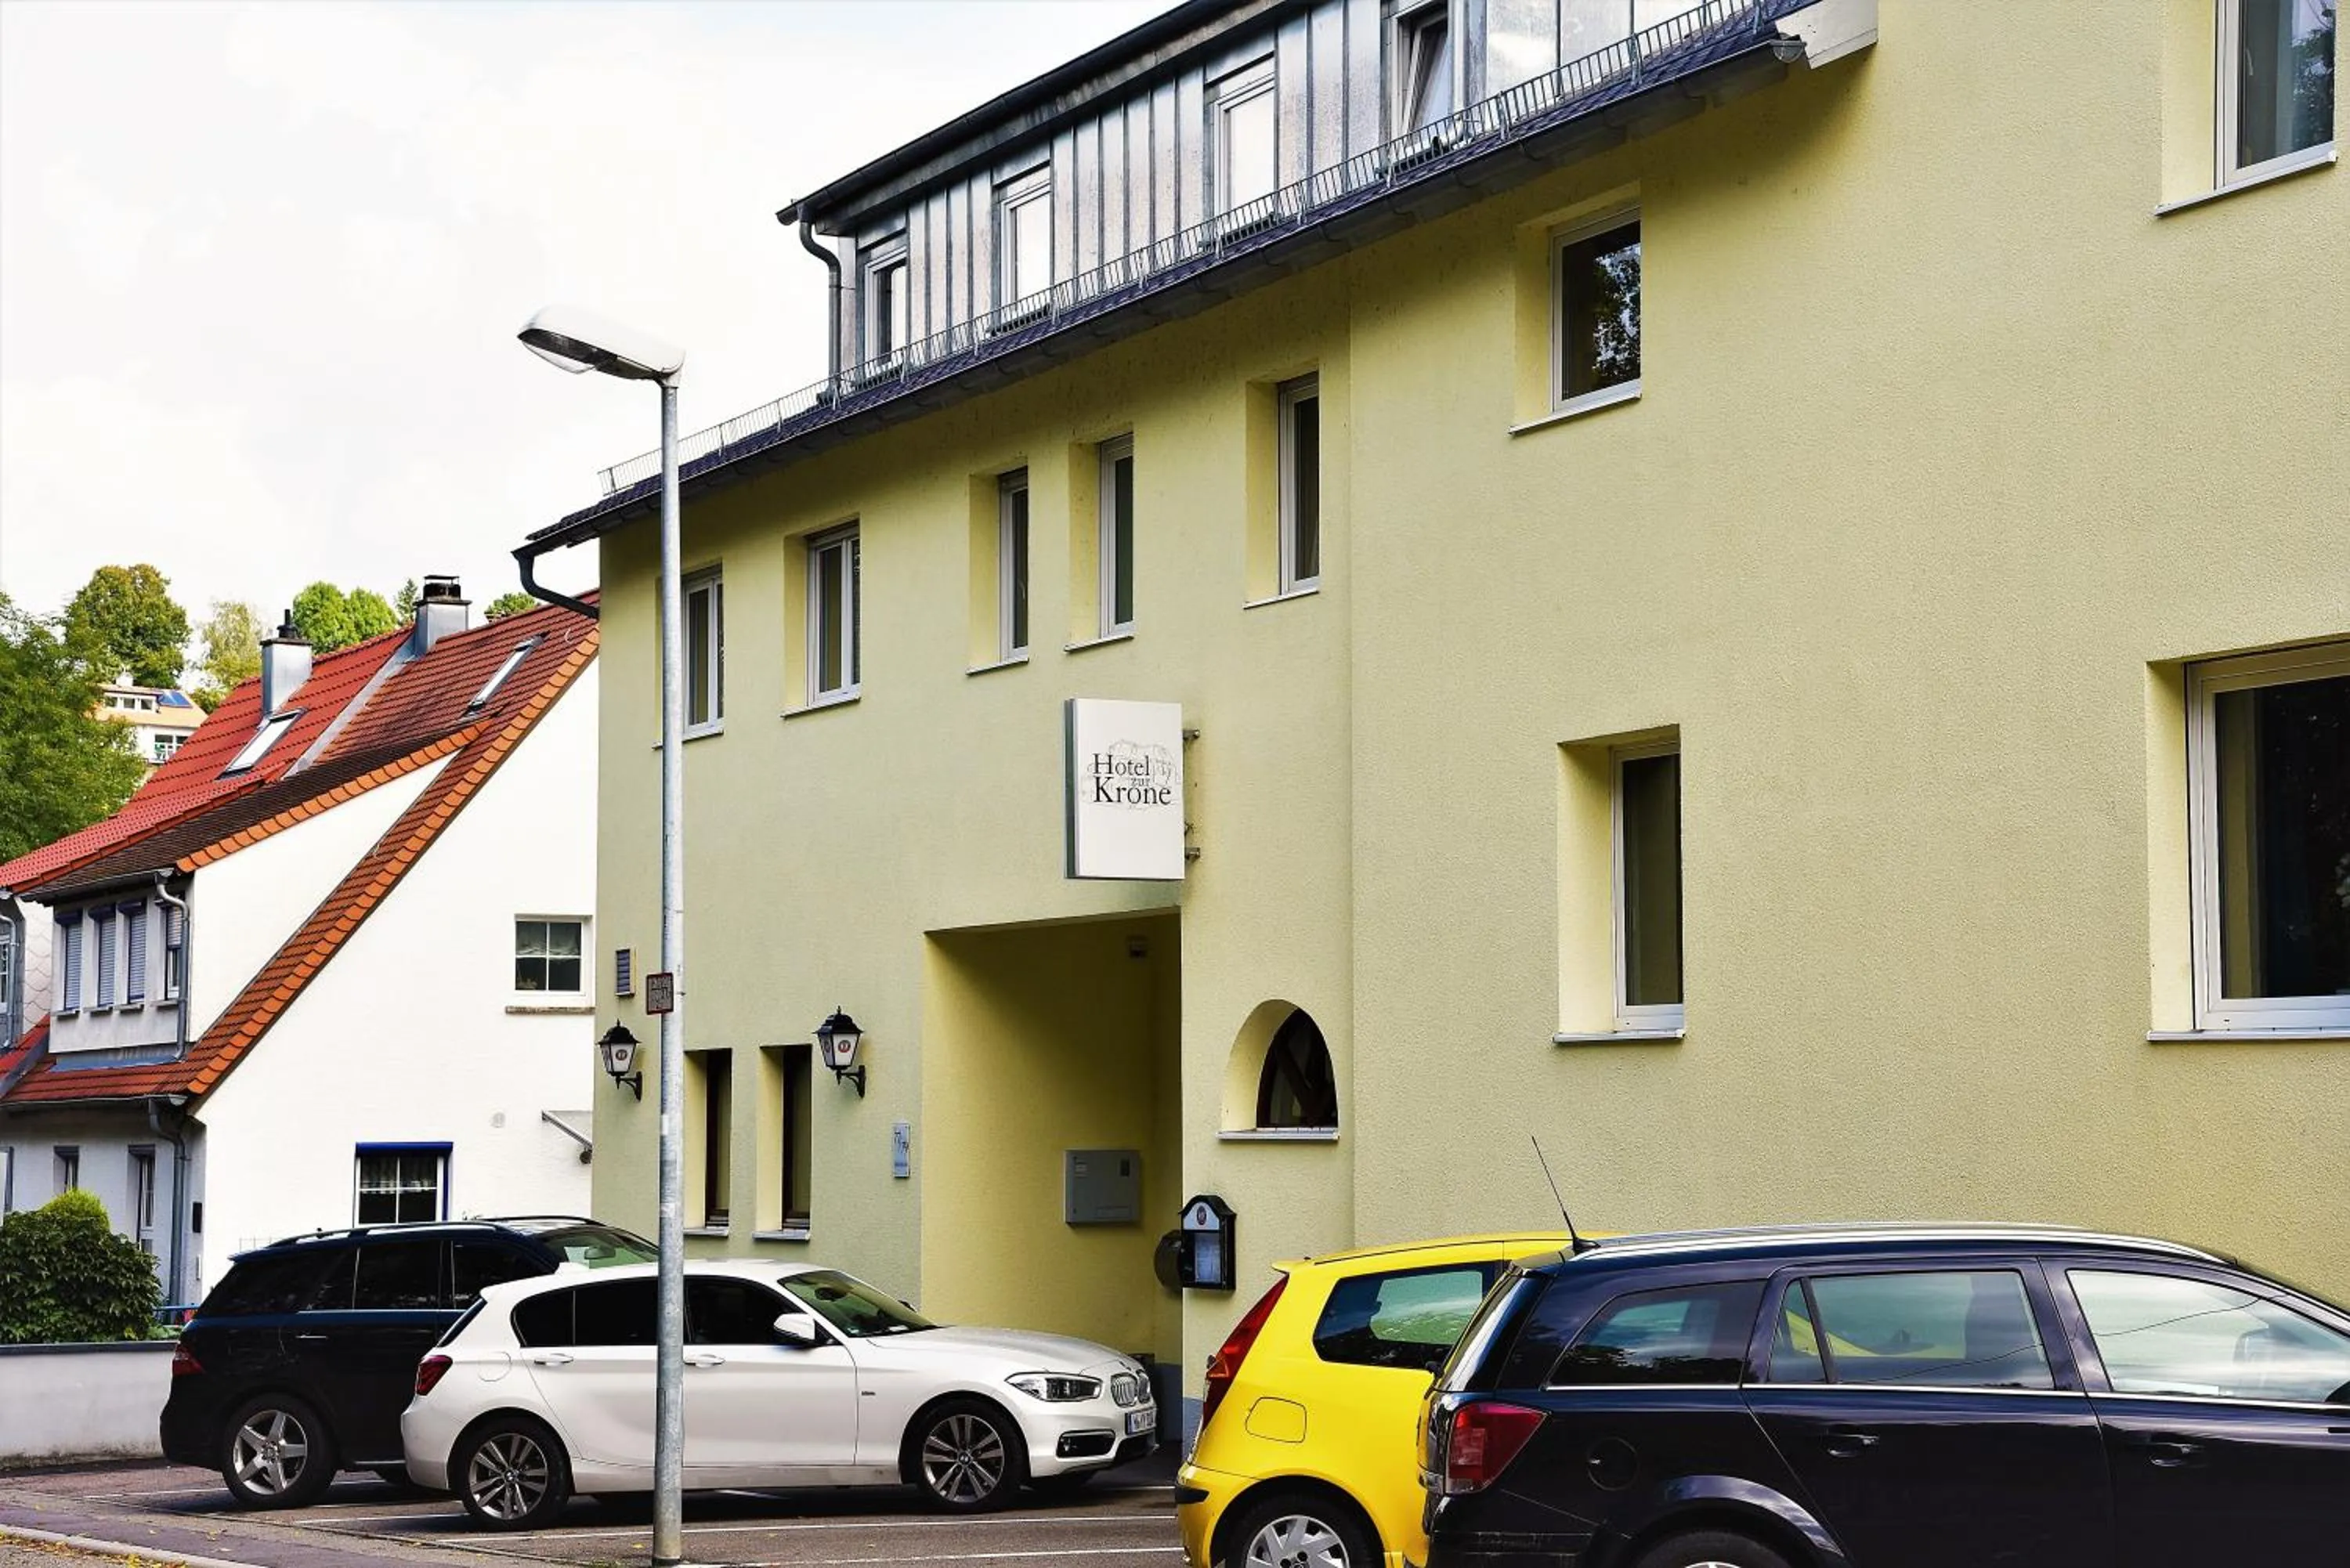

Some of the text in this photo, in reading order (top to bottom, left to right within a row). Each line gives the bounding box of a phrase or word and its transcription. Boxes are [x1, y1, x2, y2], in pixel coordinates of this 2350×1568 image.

[1092, 753, 1150, 775] Hotel
[1093, 775, 1171, 805] Krone
[1130, 777, 1151, 786] zur
